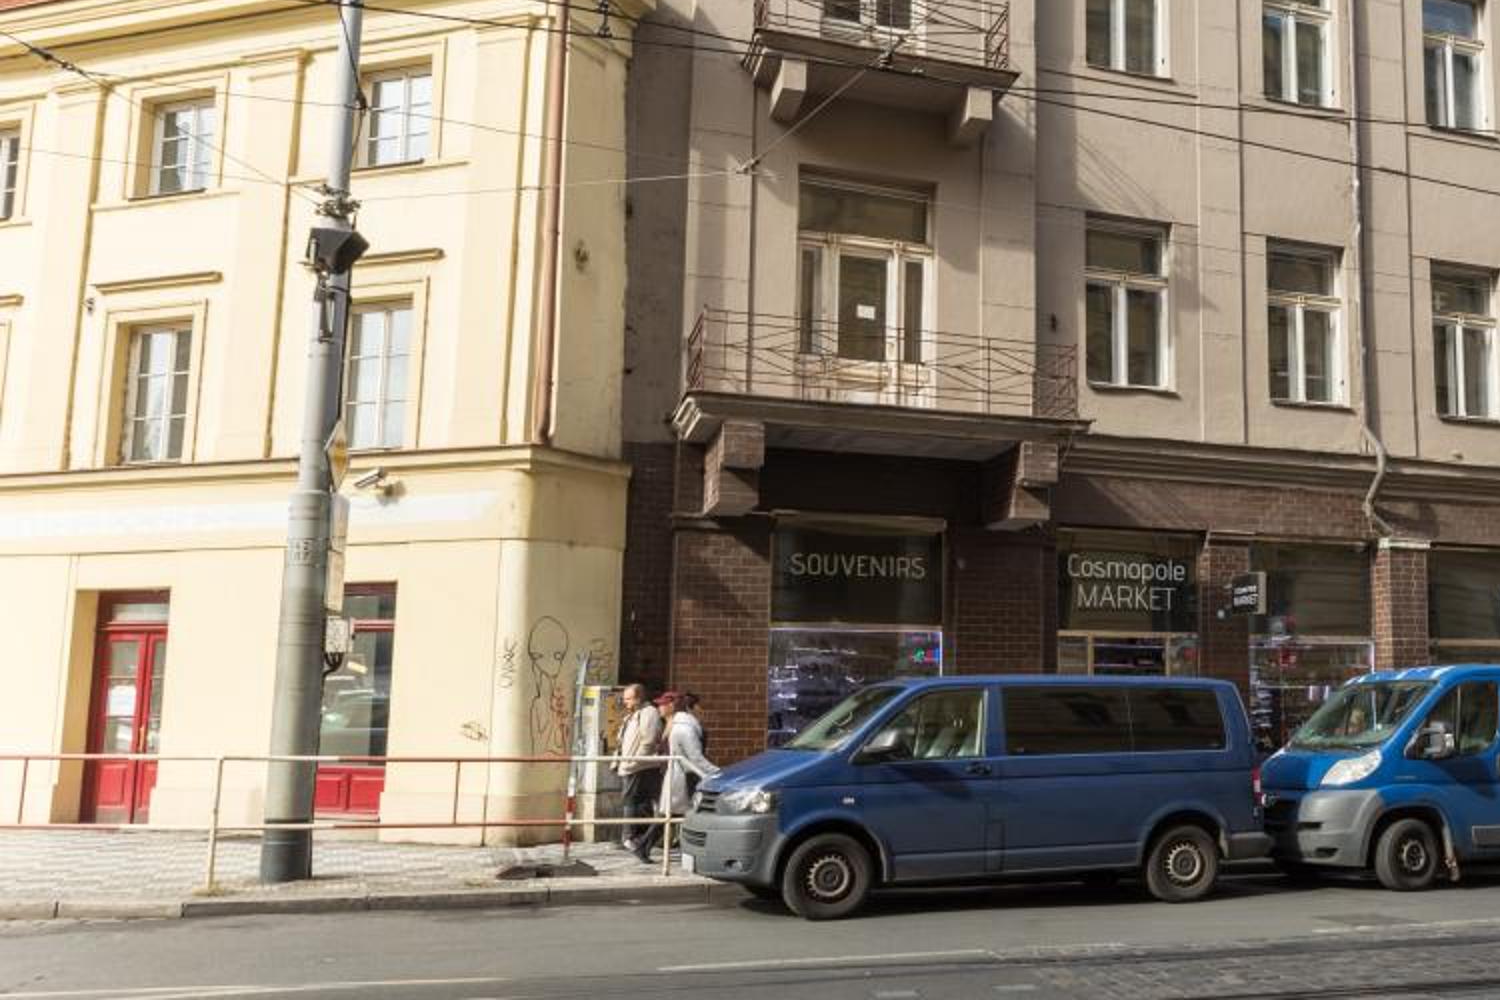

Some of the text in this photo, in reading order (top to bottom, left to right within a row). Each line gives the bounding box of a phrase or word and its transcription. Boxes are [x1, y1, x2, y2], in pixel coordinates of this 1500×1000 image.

[790, 552, 926, 580] SOUVENIRS
[1067, 553, 1185, 585] Cosmopole
[1077, 583, 1177, 611] MARKET
